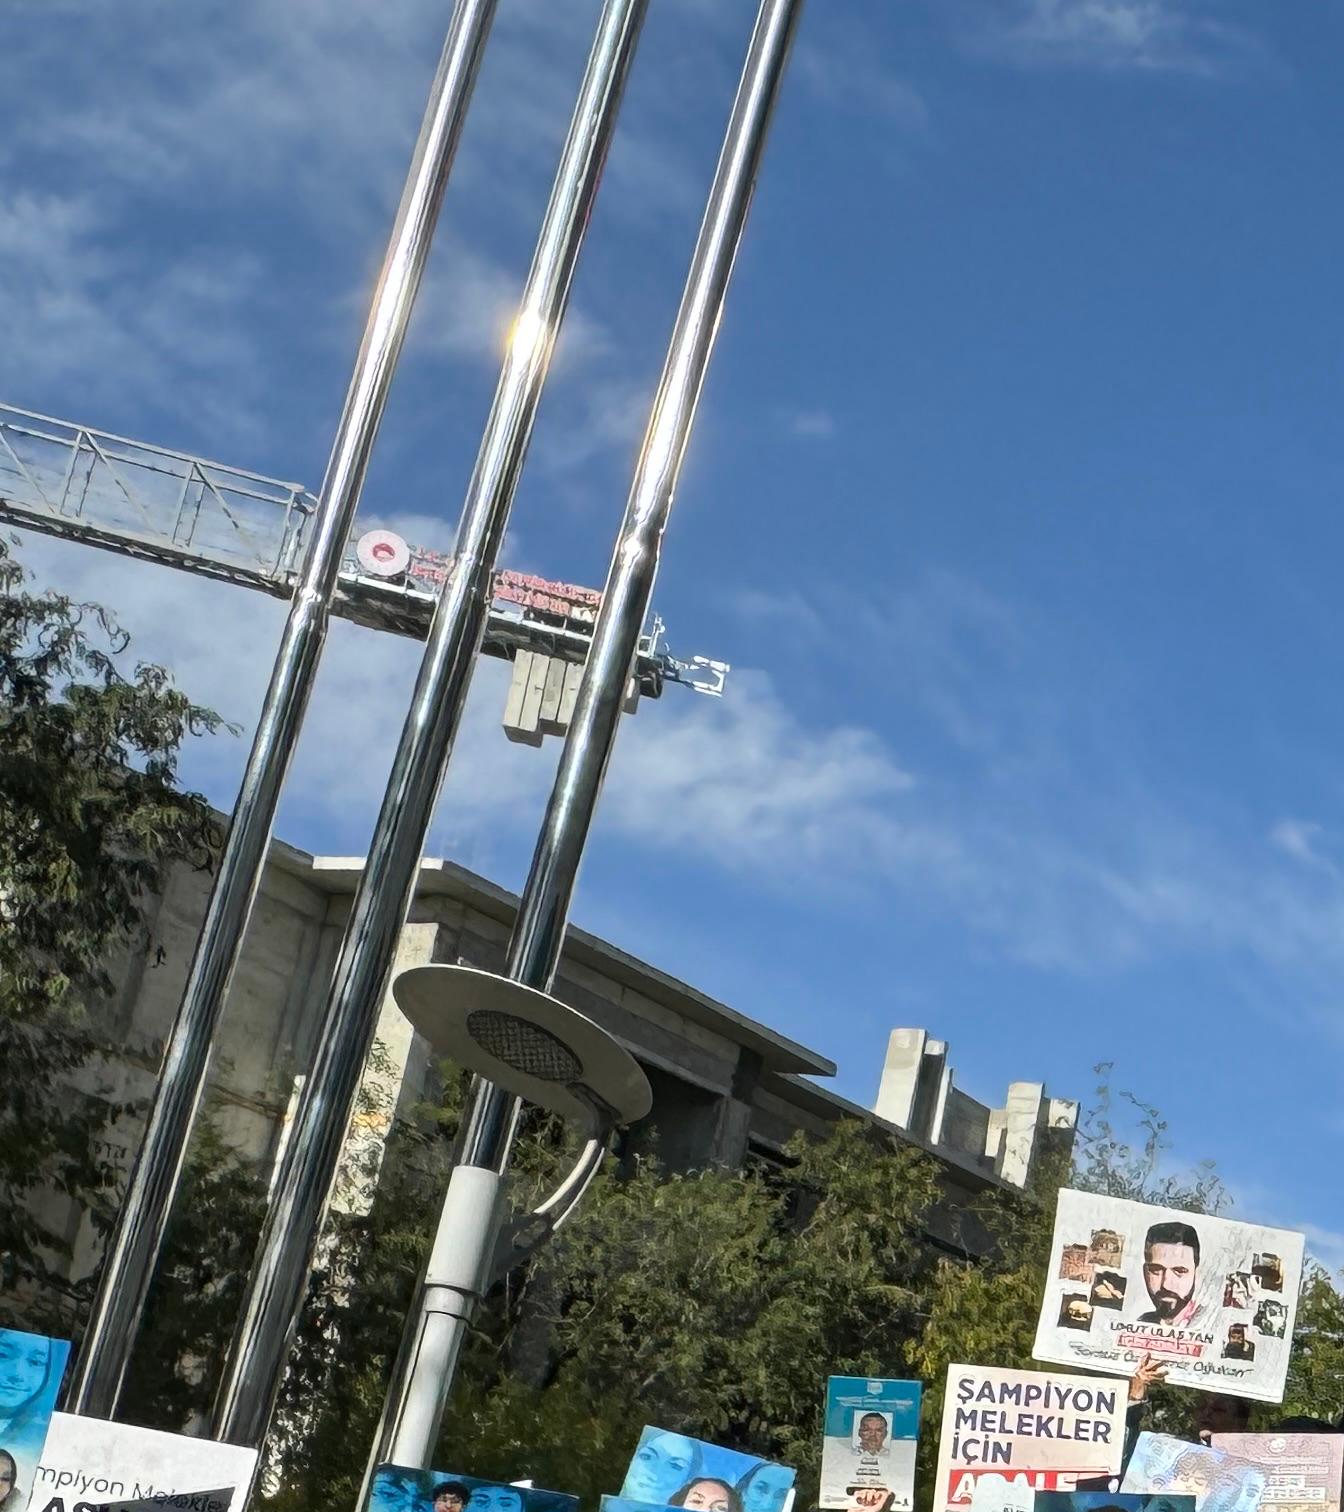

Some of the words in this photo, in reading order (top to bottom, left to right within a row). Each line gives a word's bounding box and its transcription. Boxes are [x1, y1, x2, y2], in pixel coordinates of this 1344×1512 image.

[956, 1378, 1116, 1415] ŞAMPİYON
[954, 1407, 1112, 1443] MELEKLER
[951, 1435, 1013, 1465] İÇİN
[37, 1466, 124, 1496] mpiyon
